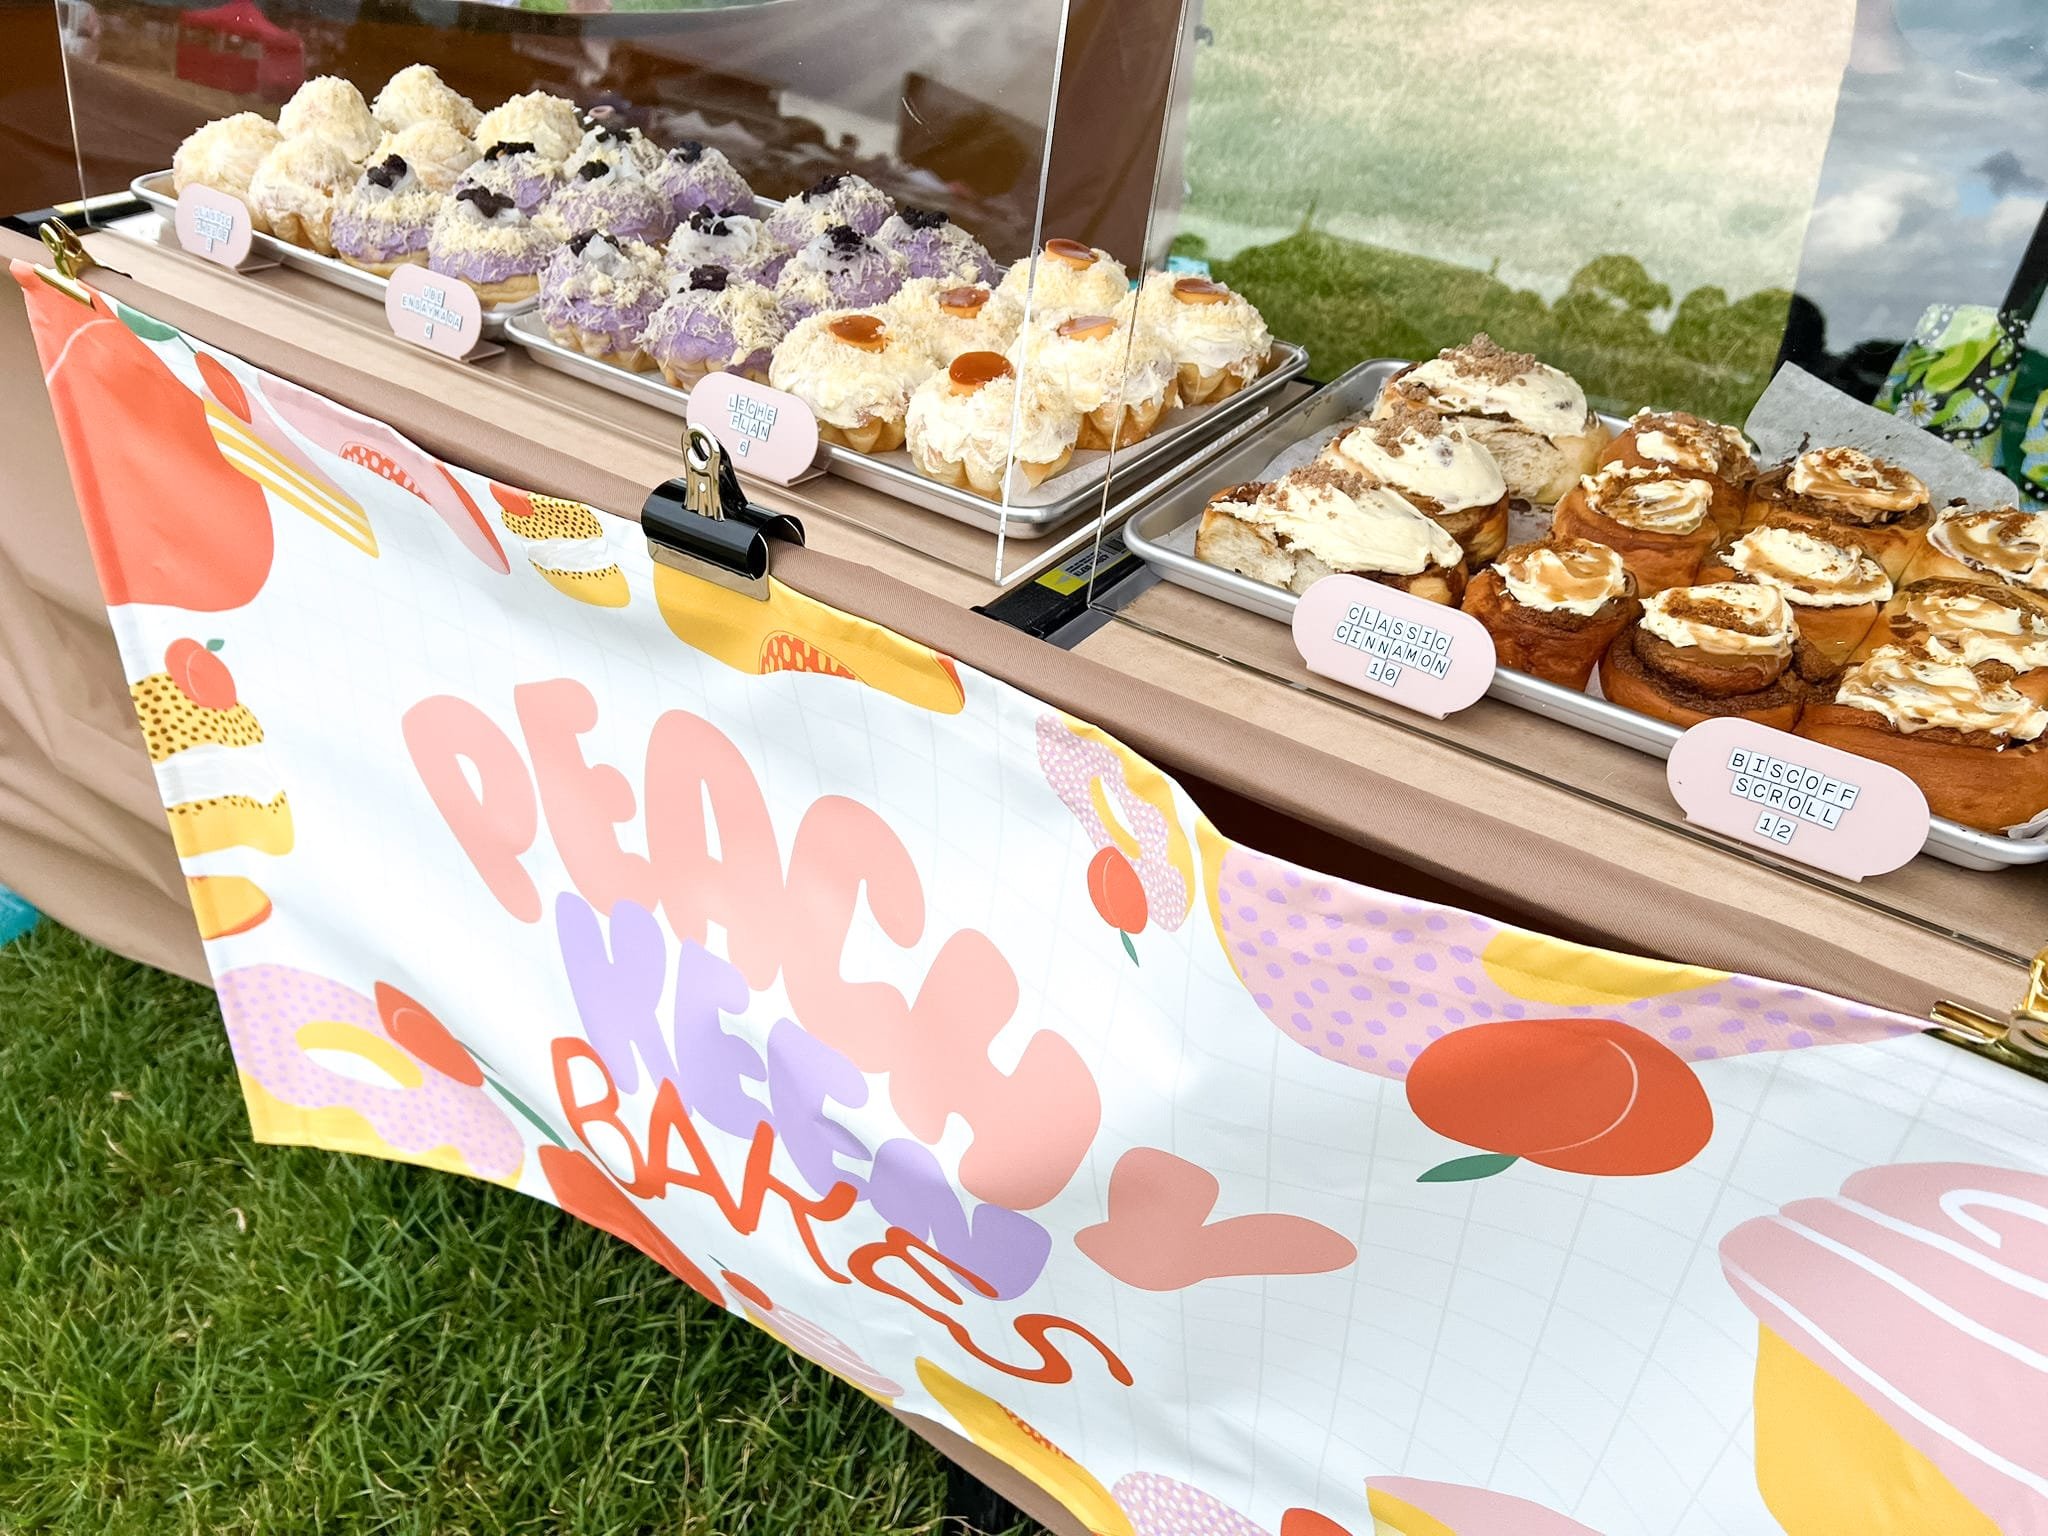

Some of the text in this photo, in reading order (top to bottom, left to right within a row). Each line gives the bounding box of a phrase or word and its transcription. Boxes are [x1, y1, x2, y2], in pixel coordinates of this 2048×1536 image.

[423, 287, 443, 304] UBE
[728, 397, 775, 419] LECHE
[731, 415, 770, 437] FLAN
[1335, 624, 1448, 676] CINNAMON
[1348, 606, 1448, 651] CLASSIC
[1369, 662, 1396, 681] 10
[1732, 752, 1856, 804] BISCOFF
[1735, 776, 1834, 826] SCROLL
[1759, 817, 1791, 839] 12
[555, 891, 1052, 1301] KEEN
[550, 1036, 1134, 1387] BAKES
